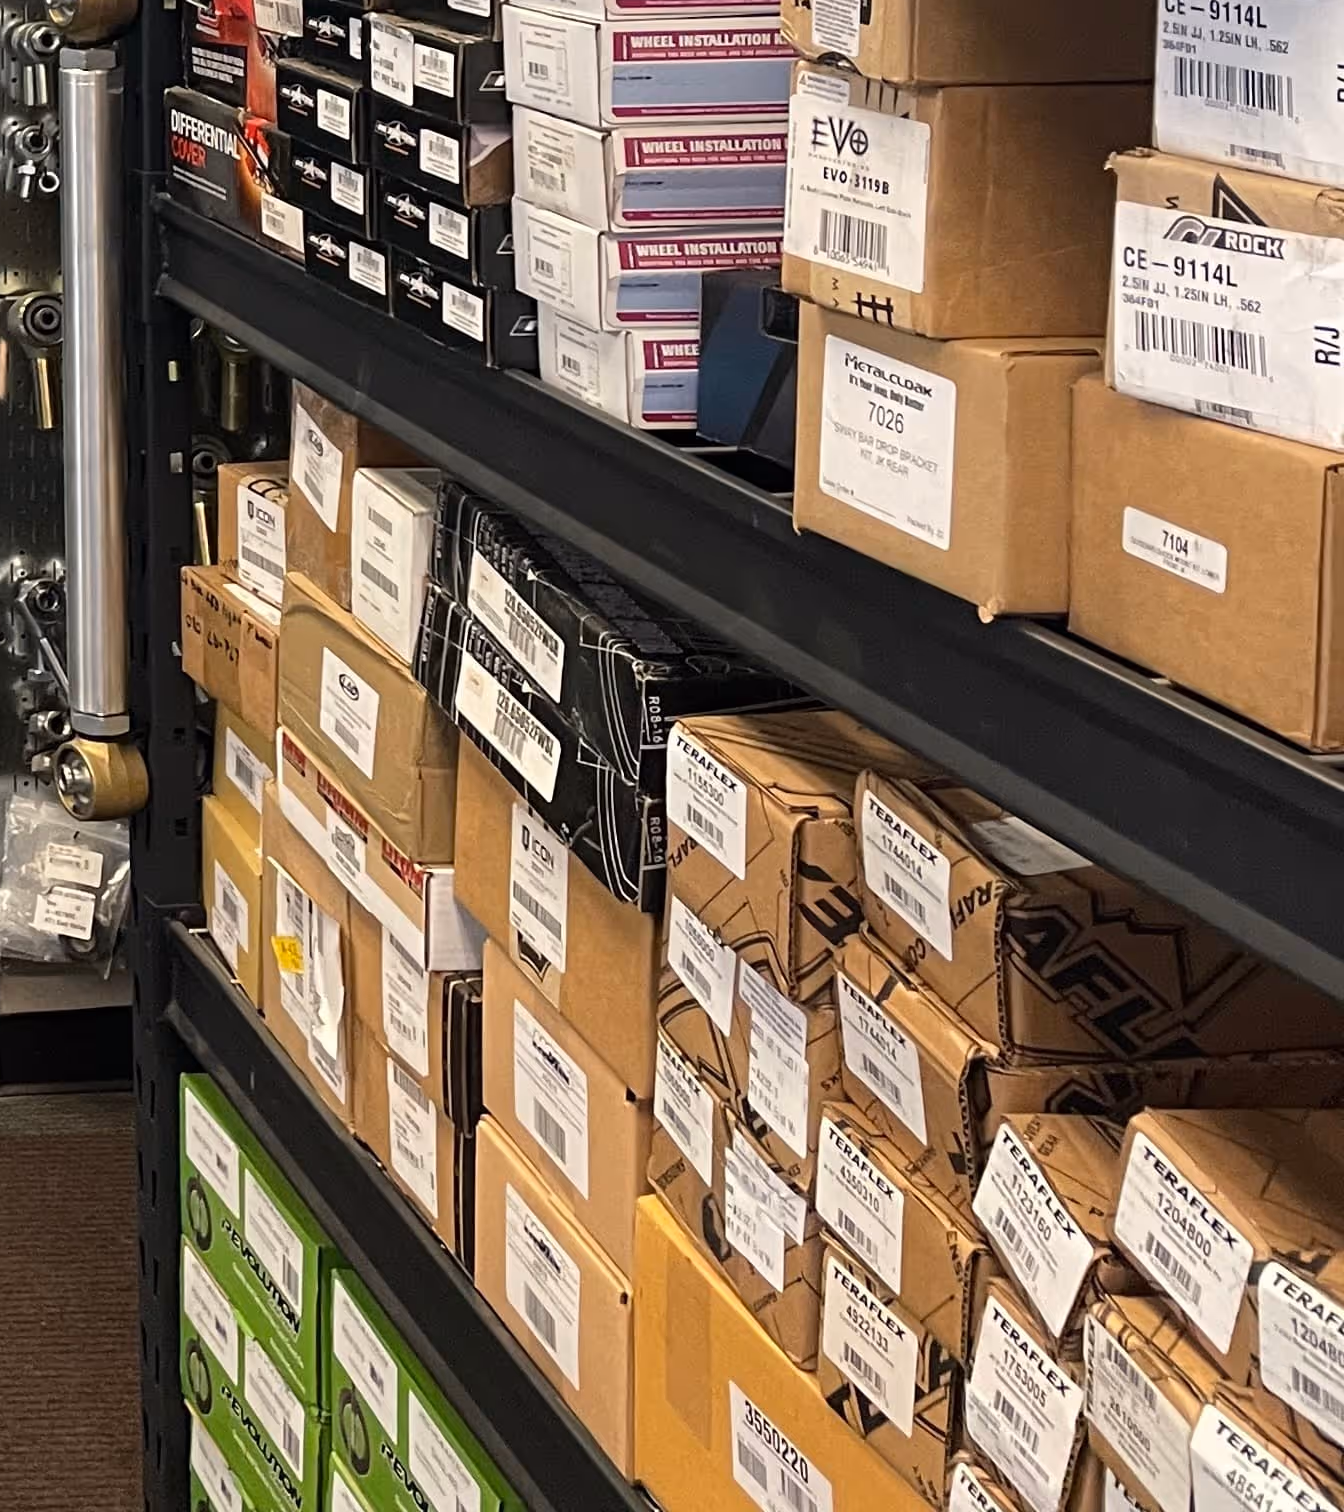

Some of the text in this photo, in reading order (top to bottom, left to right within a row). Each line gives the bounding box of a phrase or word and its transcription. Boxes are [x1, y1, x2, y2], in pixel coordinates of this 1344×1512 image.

[631, 32, 772, 49] WHEEL INSTALLATION
[171, 108, 242, 160] DIFFERENTIAL
[172, 136, 207, 168] COVER
[641, 137, 782, 154] WHEEL INSTALLATION
[636, 241, 777, 257] WHEEL INSTALLATION
[1226, 232, 1284, 259] ROCK
[1122, 276, 1149, 294] 2.5IN
[1174, 285, 1209, 304] 1.25IN
[661, 342, 700, 357] WHEE
[1314, 325, 1341, 367] R/J
[867, 400, 905, 434] 7026
[833, 421, 939, 474] SWAY BAR DROP BRACKET
[255, 507, 276, 527] ICON
[1161, 529, 1189, 557] 7104
[648, 694, 663, 745] R08-16
[675, 736, 738, 793] TERAFLEX
[532, 840, 555, 870] ICON
[649, 815, 664, 862] R08-16
[868, 797, 938, 865] TERAFLEX
[841, 981, 907, 1049] TERAFLEX
[828, 1126, 894, 1200] TERAFLEX
[1002, 1131, 1077, 1240] TERAFLEX
[1011, 1174, 1053, 1241] 1123160
[1143, 1145, 1239, 1249] TERAFLEX
[1156, 1191, 1212, 1257] 1204800
[221, 1219, 300, 1334] REVOLUTION
[832, 1266, 906, 1341] TERAFLEX
[845, 1305, 889, 1353] 4922133
[992, 1307, 1071, 1398] TERAFLEX
[1002, 1349, 1047, 1408] 1753005
[220, 1384, 302, 1509] REVOLUTION
[744, 1400, 810, 1484] 3550220
[1226, 1470, 1280, 1512] 48541
